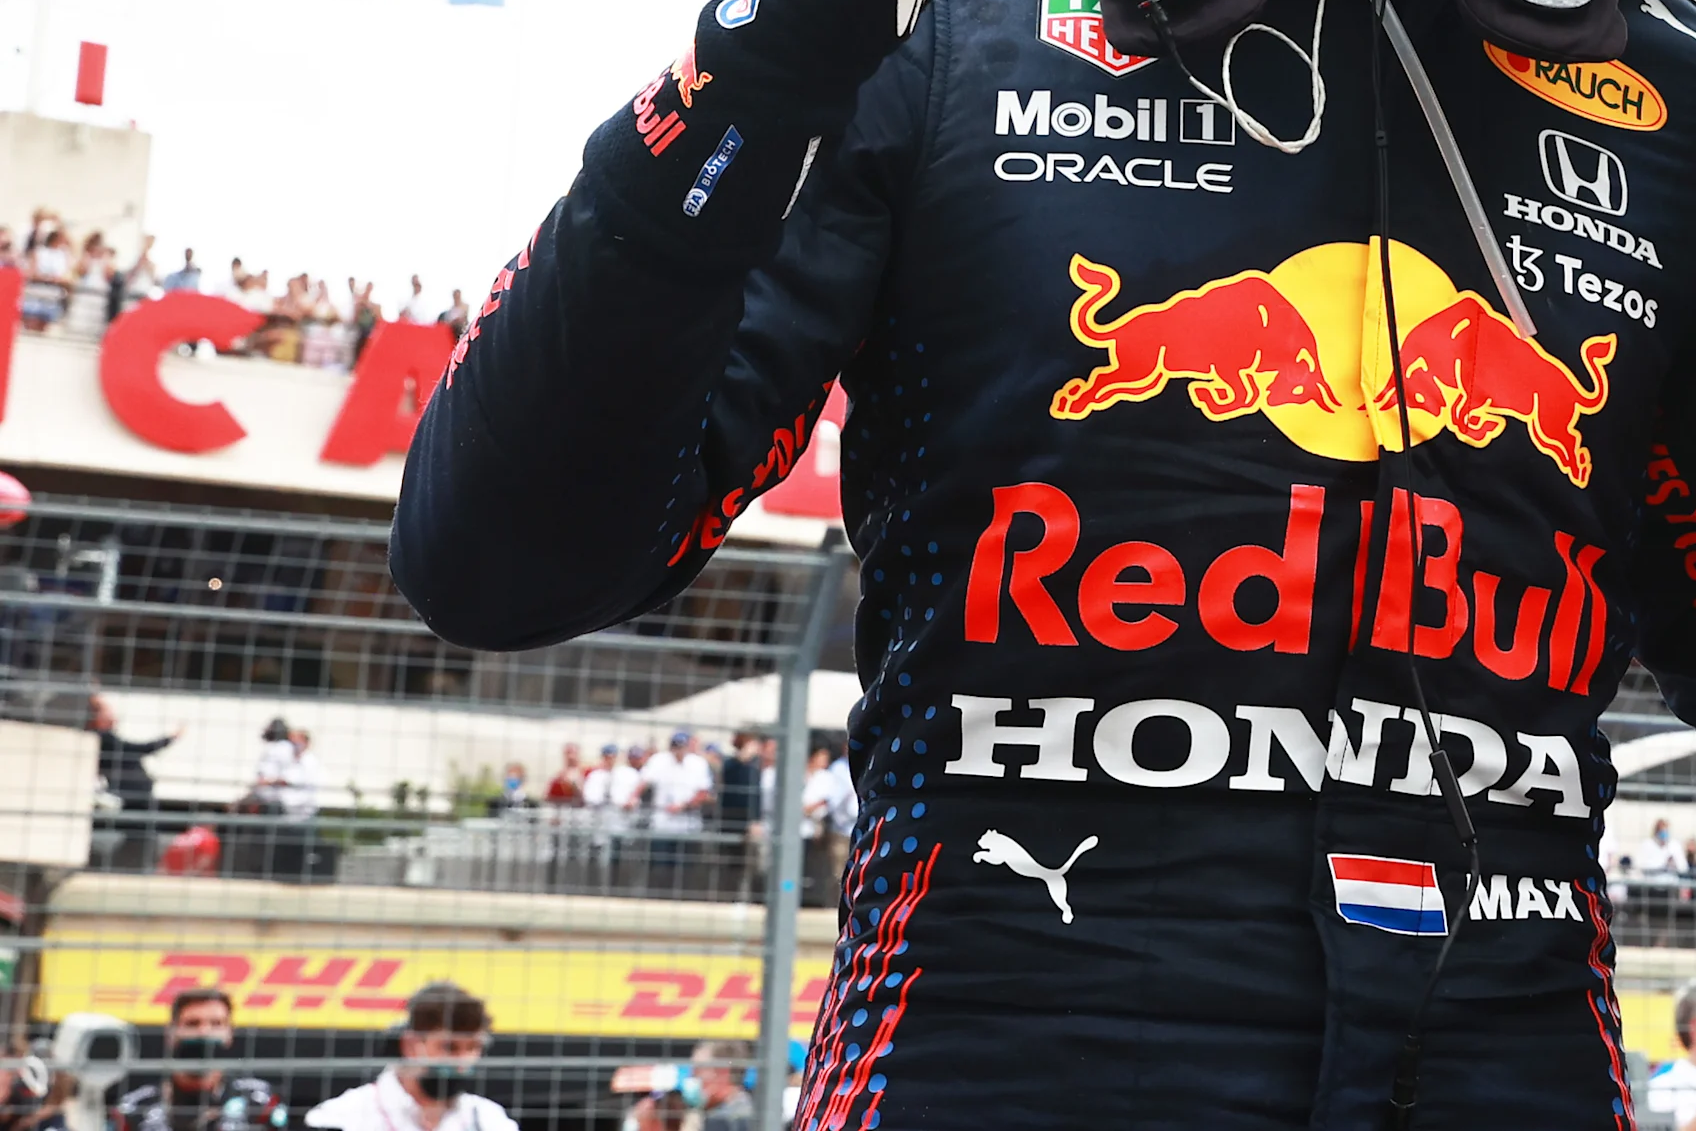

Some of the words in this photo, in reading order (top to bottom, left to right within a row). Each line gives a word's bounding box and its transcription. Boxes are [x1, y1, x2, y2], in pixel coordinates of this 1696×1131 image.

[995, 90, 1167, 142] Mobil
[1534, 60, 1644, 121] RAUCH
[993, 151, 1234, 194] ORACLE
[1503, 192, 1663, 270] HONDA
[1554, 253, 1658, 329] Tezos
[964, 481, 1326, 655] Red
[1349, 486, 1607, 697] Bull
[944, 693, 1592, 819] HONDA
[1468, 877, 1585, 922] MAX
[153, 954, 409, 1011] DHL
